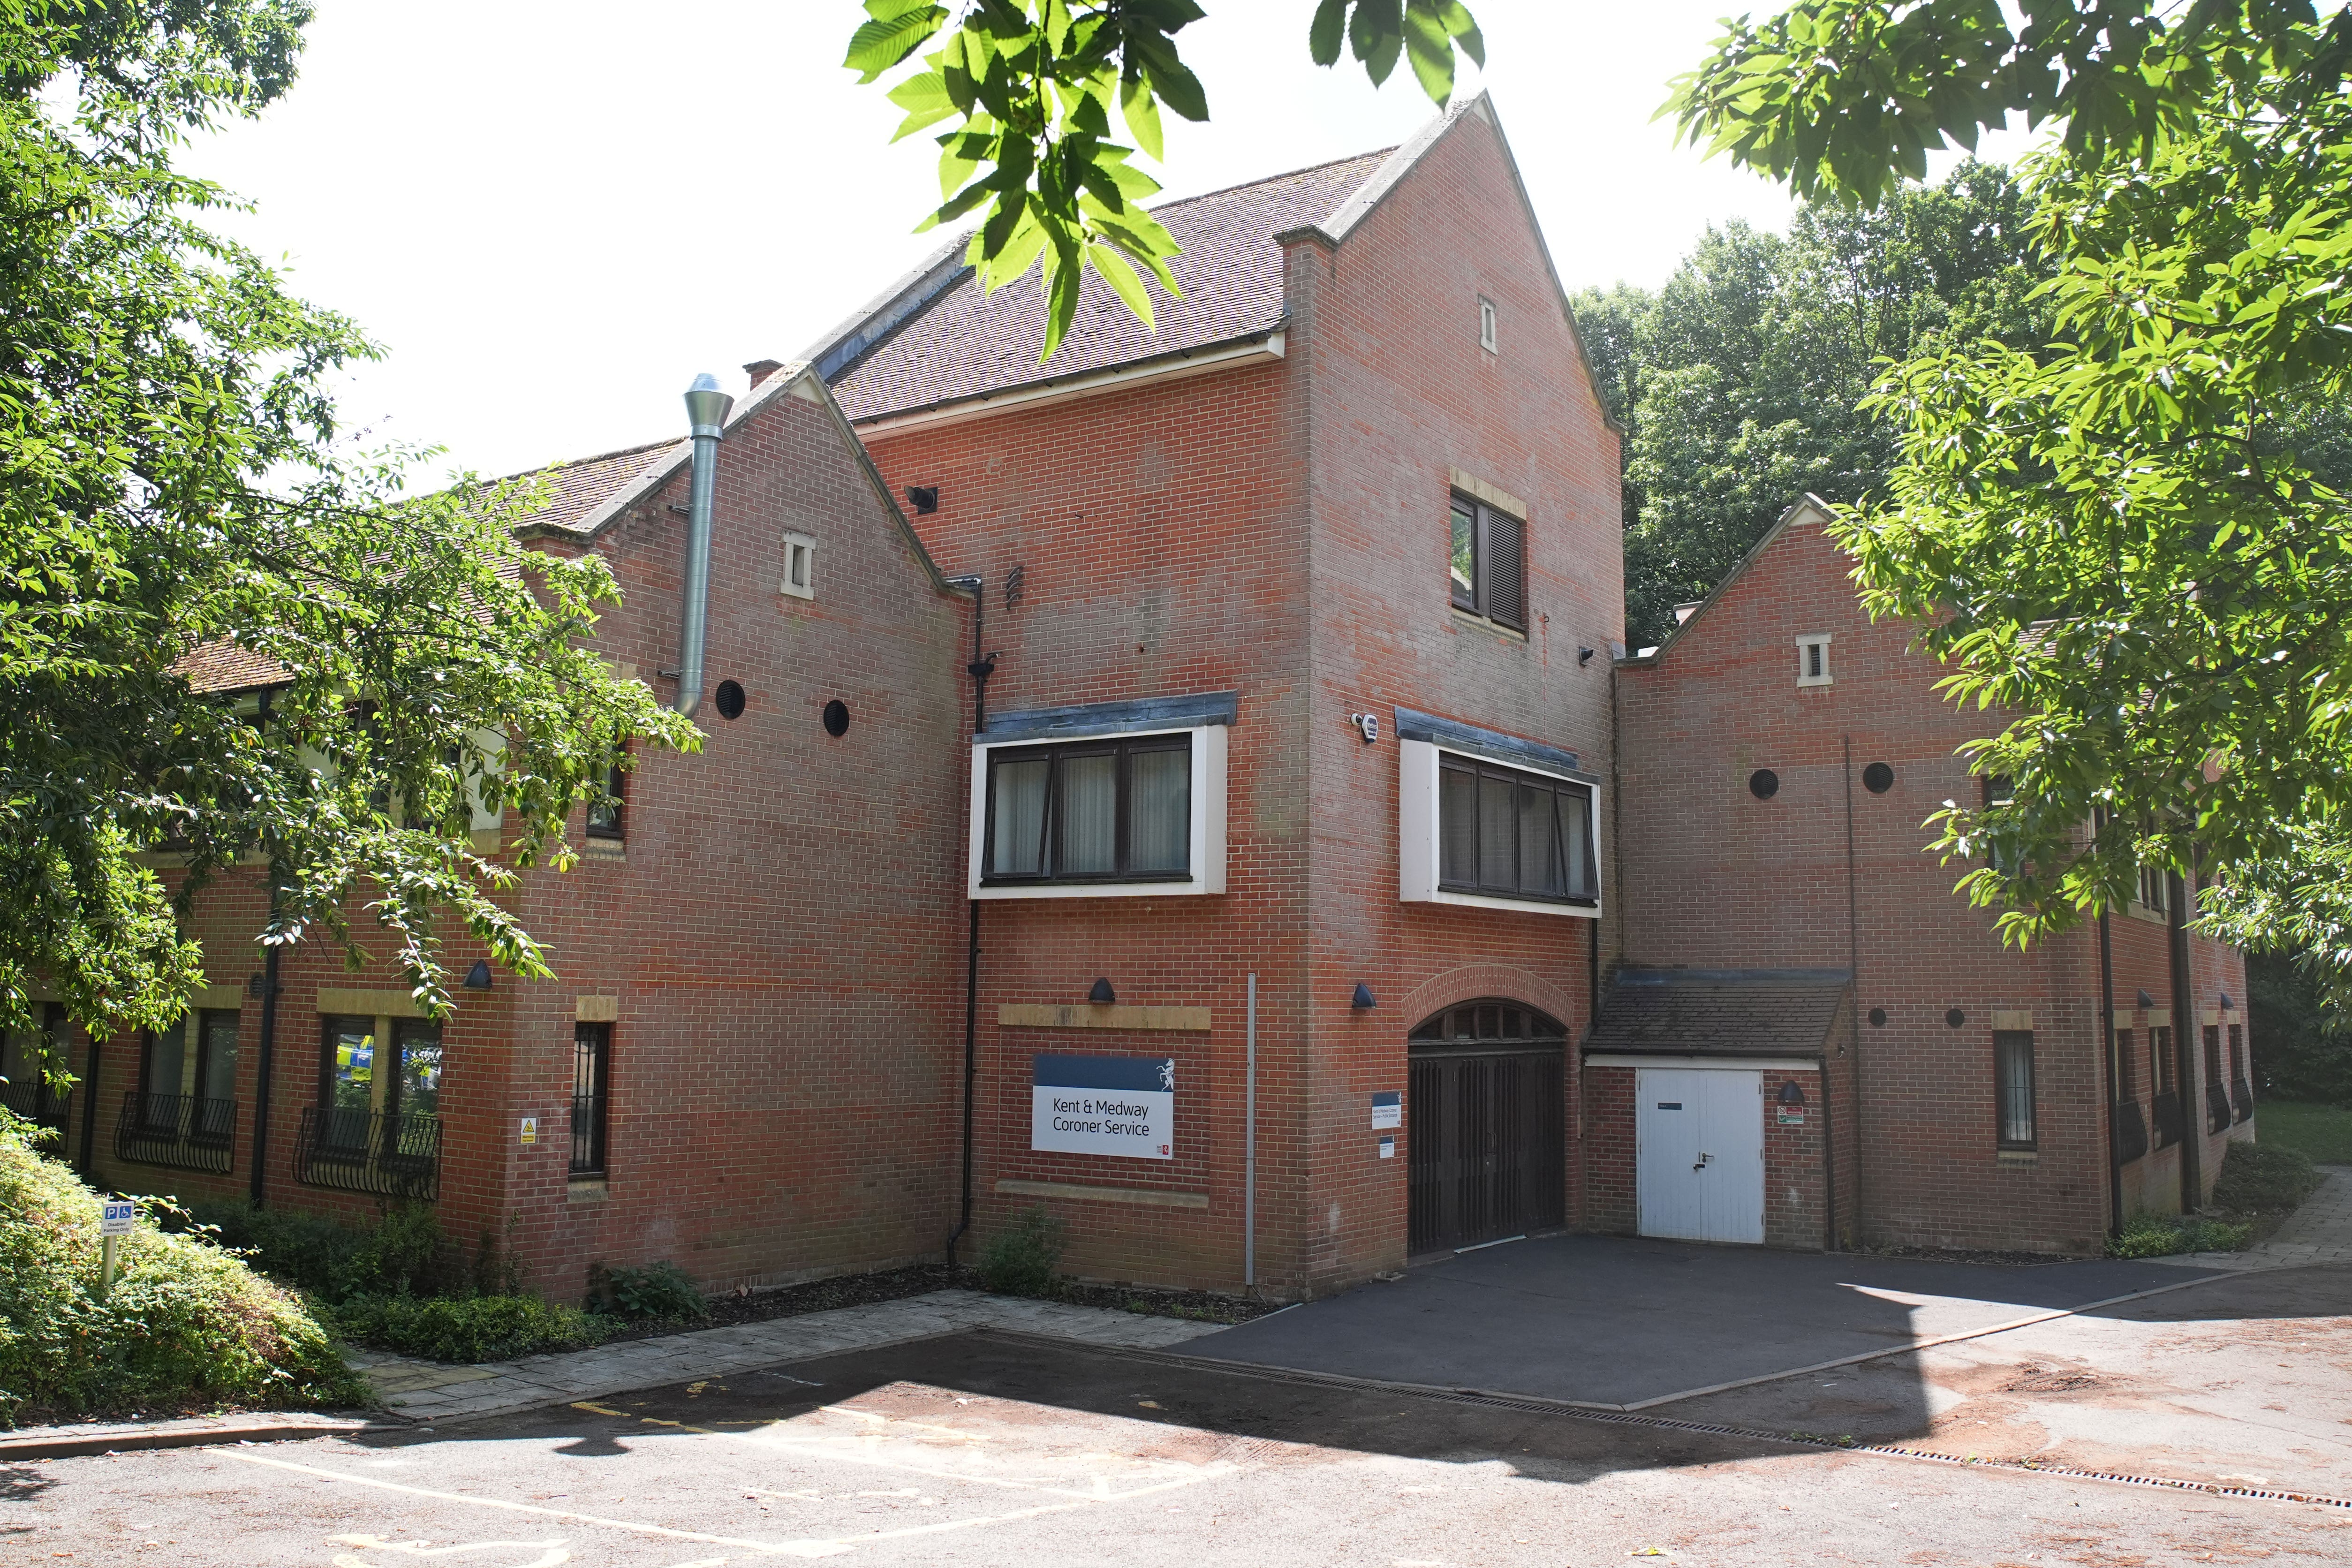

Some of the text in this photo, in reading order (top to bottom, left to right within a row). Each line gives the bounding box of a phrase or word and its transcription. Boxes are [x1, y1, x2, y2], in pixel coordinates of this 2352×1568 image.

[1054, 1098, 1149, 1120] Kent & Medway
[1053, 1117, 1149, 1136] Coroner Service
[107, 1208, 115, 1218] P
